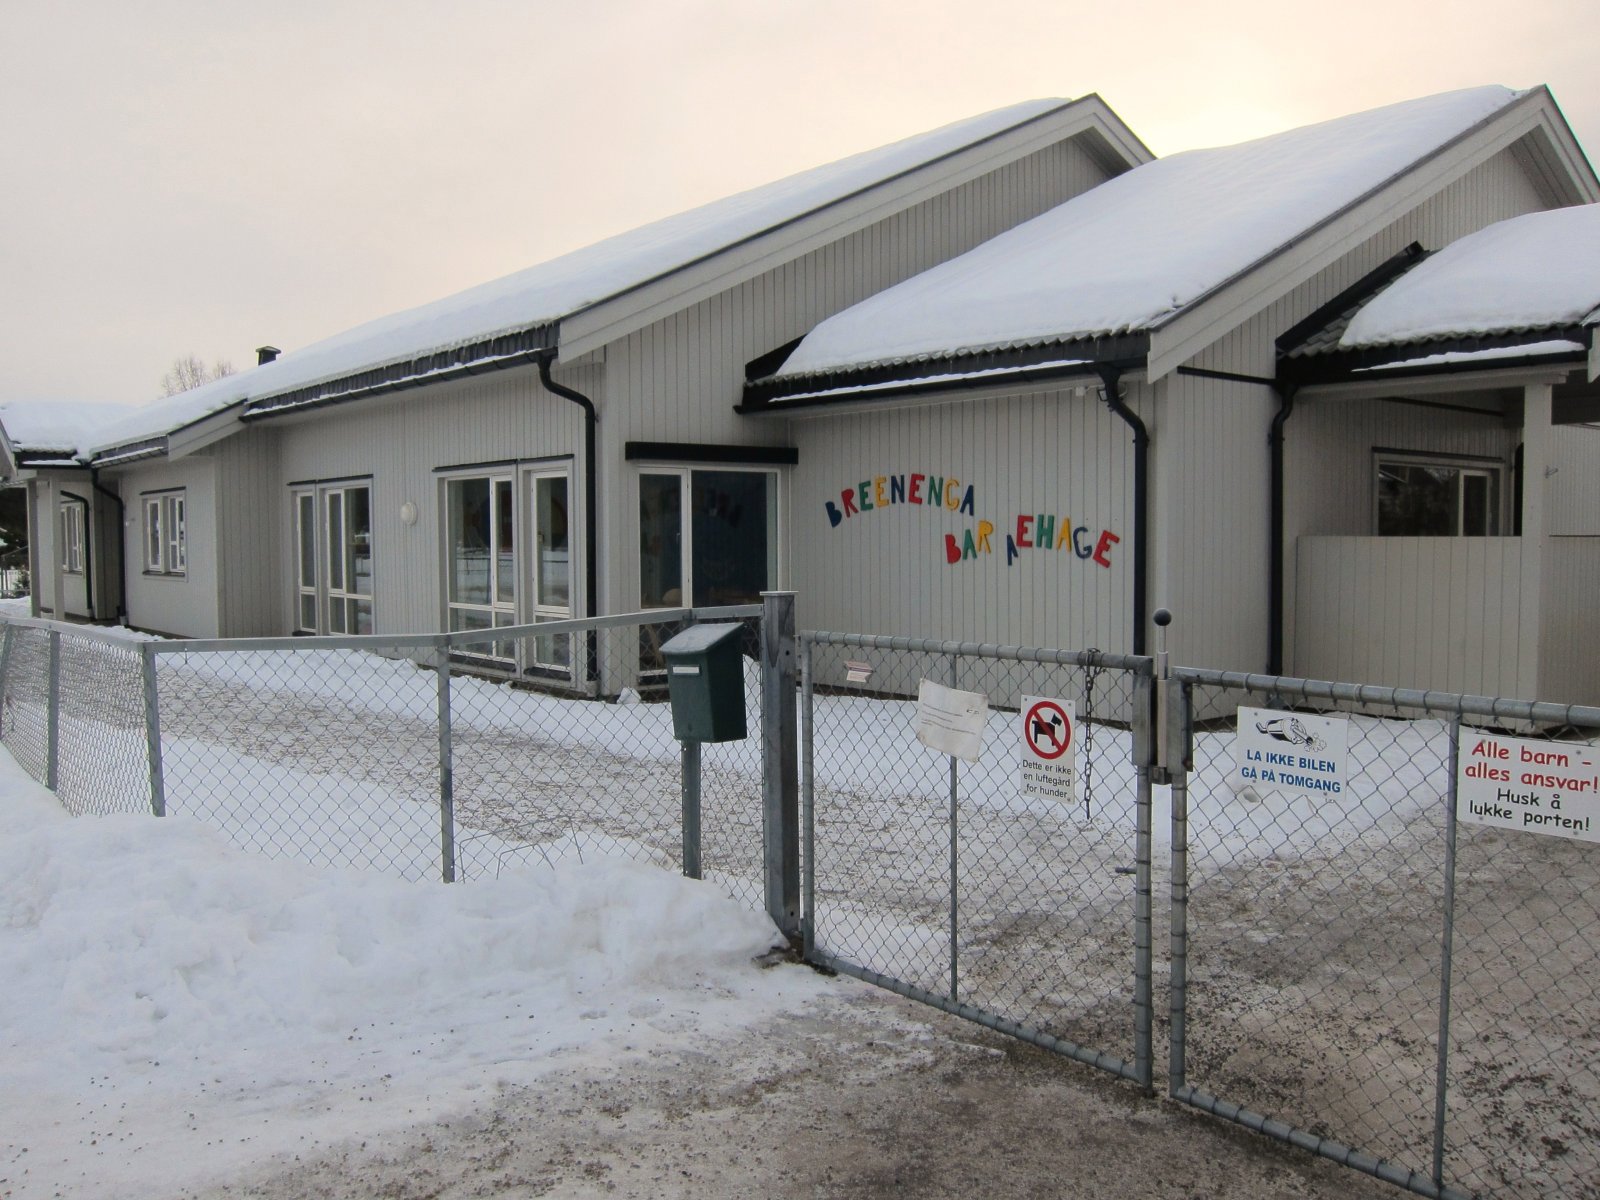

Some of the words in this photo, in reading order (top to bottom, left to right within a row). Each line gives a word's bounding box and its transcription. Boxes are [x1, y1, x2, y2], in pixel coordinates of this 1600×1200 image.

[825, 473, 975, 528] BREENENGA
[1246, 749, 1262, 761] LA
[1266, 752, 1295, 766] IKKE
[1298, 757, 1336, 773] BILEN
[1471, 741, 1510, 760] Alle
[1520, 745, 1569, 767] barn
[1022, 759, 1043, 770] Dette
[1044, 763, 1053, 772] er
[1055, 764, 1072, 775] ikke
[1241, 766, 1258, 779] GÅ
[1261, 769, 1276, 782] PÅ
[1279, 772, 1341, 793] TOMGANG
[1465, 762, 1510, 781] alles
[1520, 772, 1599, 794] ansvar!
[1026, 783, 1038, 792] for
[1039, 786, 1068, 799] hunder
[1035, 774, 1071, 787] luftegård
[1497, 788, 1540, 807] Husk
[1550, 793, 1561, 810] å
[1469, 800, 1513, 820] lukke
[1523, 811, 1590, 832] porten!
